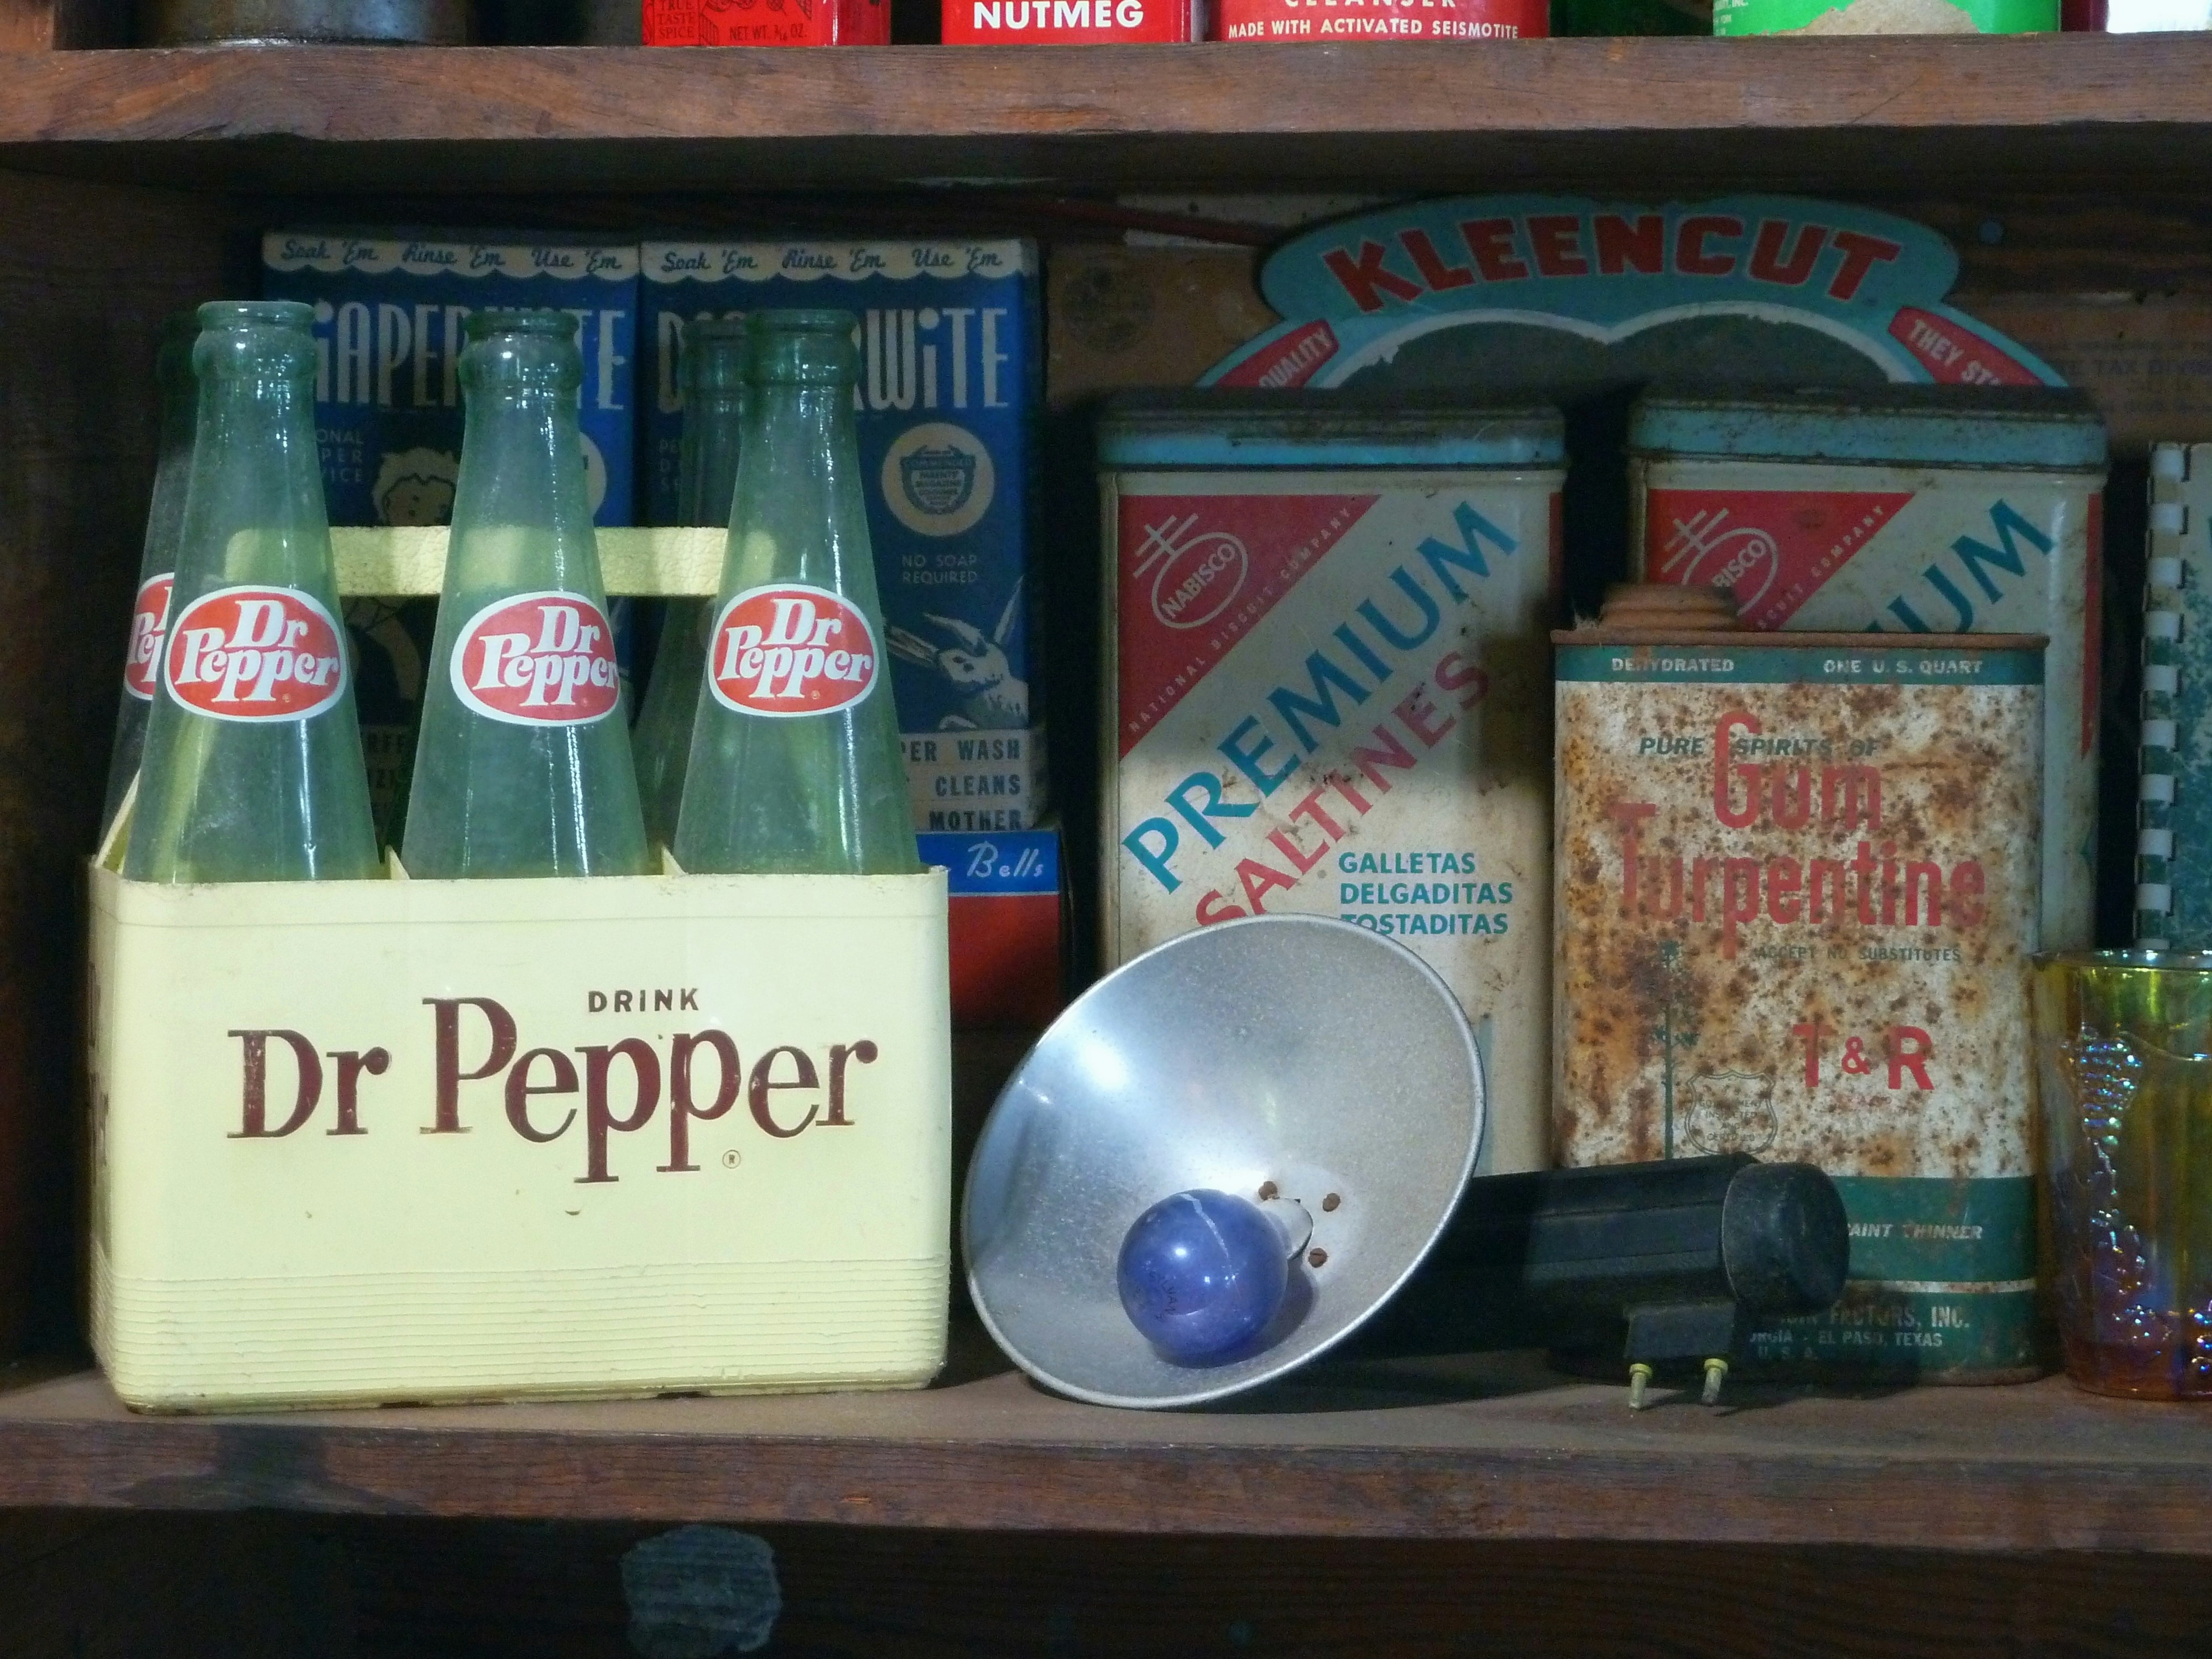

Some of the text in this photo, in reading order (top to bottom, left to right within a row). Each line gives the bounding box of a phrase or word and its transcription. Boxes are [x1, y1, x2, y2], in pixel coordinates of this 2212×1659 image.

[974, 0, 1143, 29] NUTMEG
[1229, 18, 1518, 39] MADE WITH ACTIVATED SEISMOTITE
[729, 26, 748, 41] NET
[281, 239, 330, 260] Soak
[402, 243, 457, 265] Rinse
[530, 247, 575, 268] Use
[661, 250, 710, 273] Soak
[781, 248, 838, 270] Rinse
[911, 247, 954, 267] Use
[1322, 214, 1902, 312] KLEENCUT
[1259, 327, 1332, 388] QUALITY
[1909, 319, 1999, 385] THEY ST
[1811, 505, 1884, 577] COMPANY
[902, 555, 977, 567] NO SOAP
[902, 571, 977, 584] REQUIRED
[1712, 539, 1766, 588] BISCO
[1162, 542, 1237, 619] NABISCO
[225, 599, 309, 648] Dr
[530, 606, 600, 653] Dr
[761, 599, 842, 646] Dr
[1128, 508, 1350, 733] NATIONAL BISCUIT COMPANY
[174, 627, 340, 702] Pepper
[472, 633, 617, 706] Pepper
[717, 625, 873, 698] Pepper
[1824, 659, 1861, 674] ONE
[1919, 660, 1982, 675] QUART
[1122, 500, 1520, 895] PREMIUM
[957, 739, 1020, 761] WASH
[1639, 736, 1880, 757] PURE SPIRITS OF
[935, 774, 1021, 796] CLEANS
[1713, 709, 1879, 831] Gum
[1196, 651, 1489, 926] SALTINES
[929, 810, 1022, 831] MOTHER
[967, 841, 1044, 878] Bells
[1339, 852, 1475, 874] GALLETAS
[1340, 882, 1512, 904] DELGADITAS
[1607, 802, 1986, 959] Turpentine
[1858, 946, 1961, 962] SUBSTITUTES
[588, 988, 699, 1013] DRINK
[227, 1029, 393, 1138] Dr
[420, 998, 879, 1183] Pepper
[1848, 1224, 1893, 1238] AINT
[1932, 1305, 1970, 1328] INC.
[1819, 1331, 1836, 1345] EL
[1894, 1332, 1943, 1347] TEXAS
